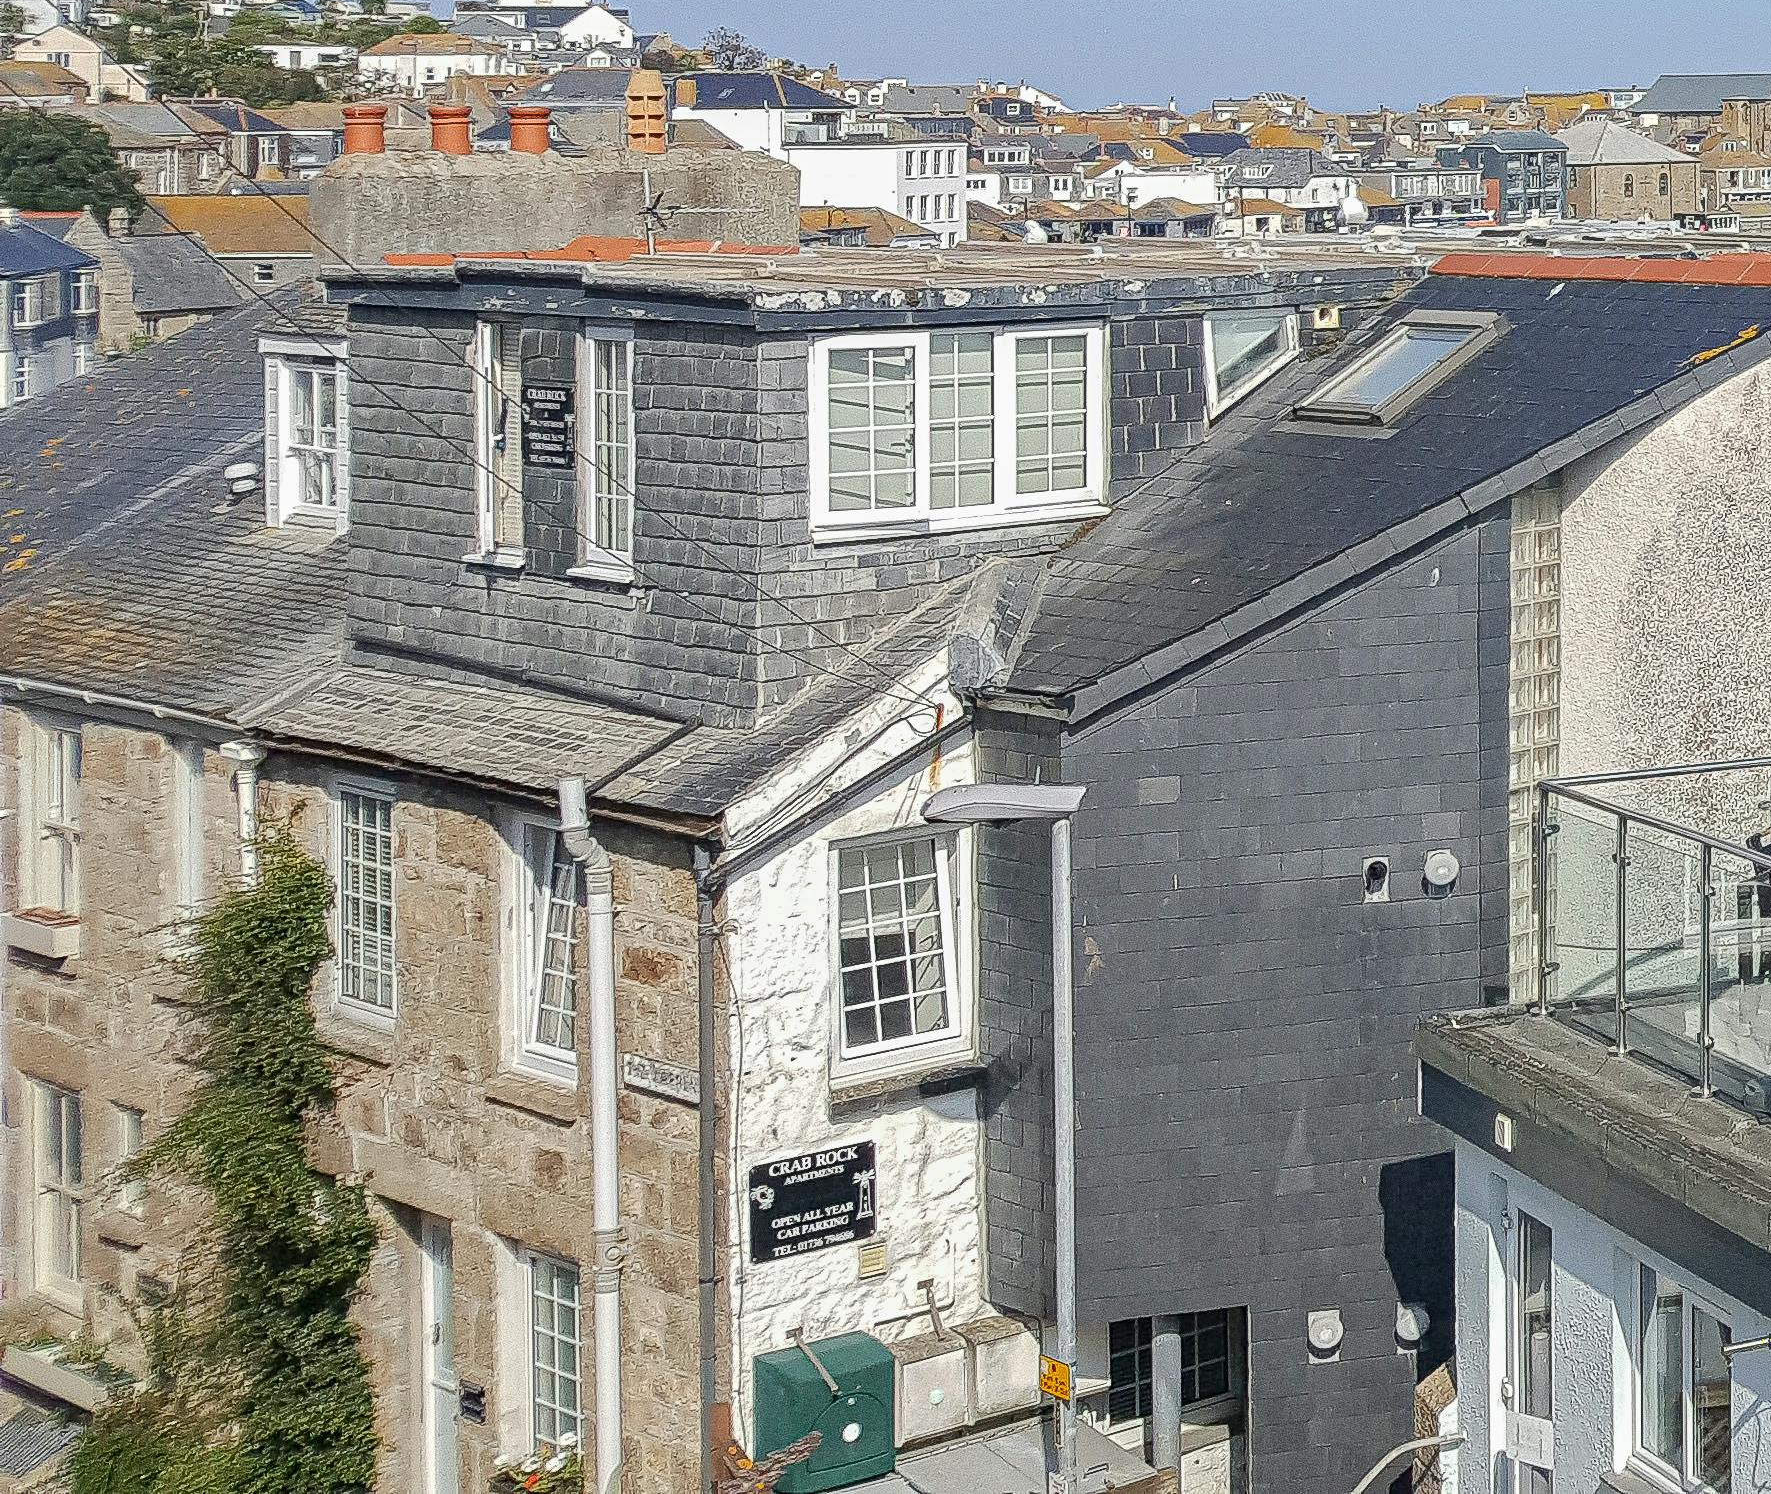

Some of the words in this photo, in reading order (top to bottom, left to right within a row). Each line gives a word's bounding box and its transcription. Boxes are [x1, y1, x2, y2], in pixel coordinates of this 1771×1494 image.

[768, 1157, 812, 1177] CRAB
[816, 1146, 858, 1167] ROCK
[783, 1164, 845, 1186] APARTMENTS
[771, 1212, 801, 1228] OPEN
[802, 1208, 825, 1222] ALL
[825, 1201, 854, 1217] YEAR
[776, 1227, 801, 1240] CAR
[801, 1215, 849, 1235] PARKING
